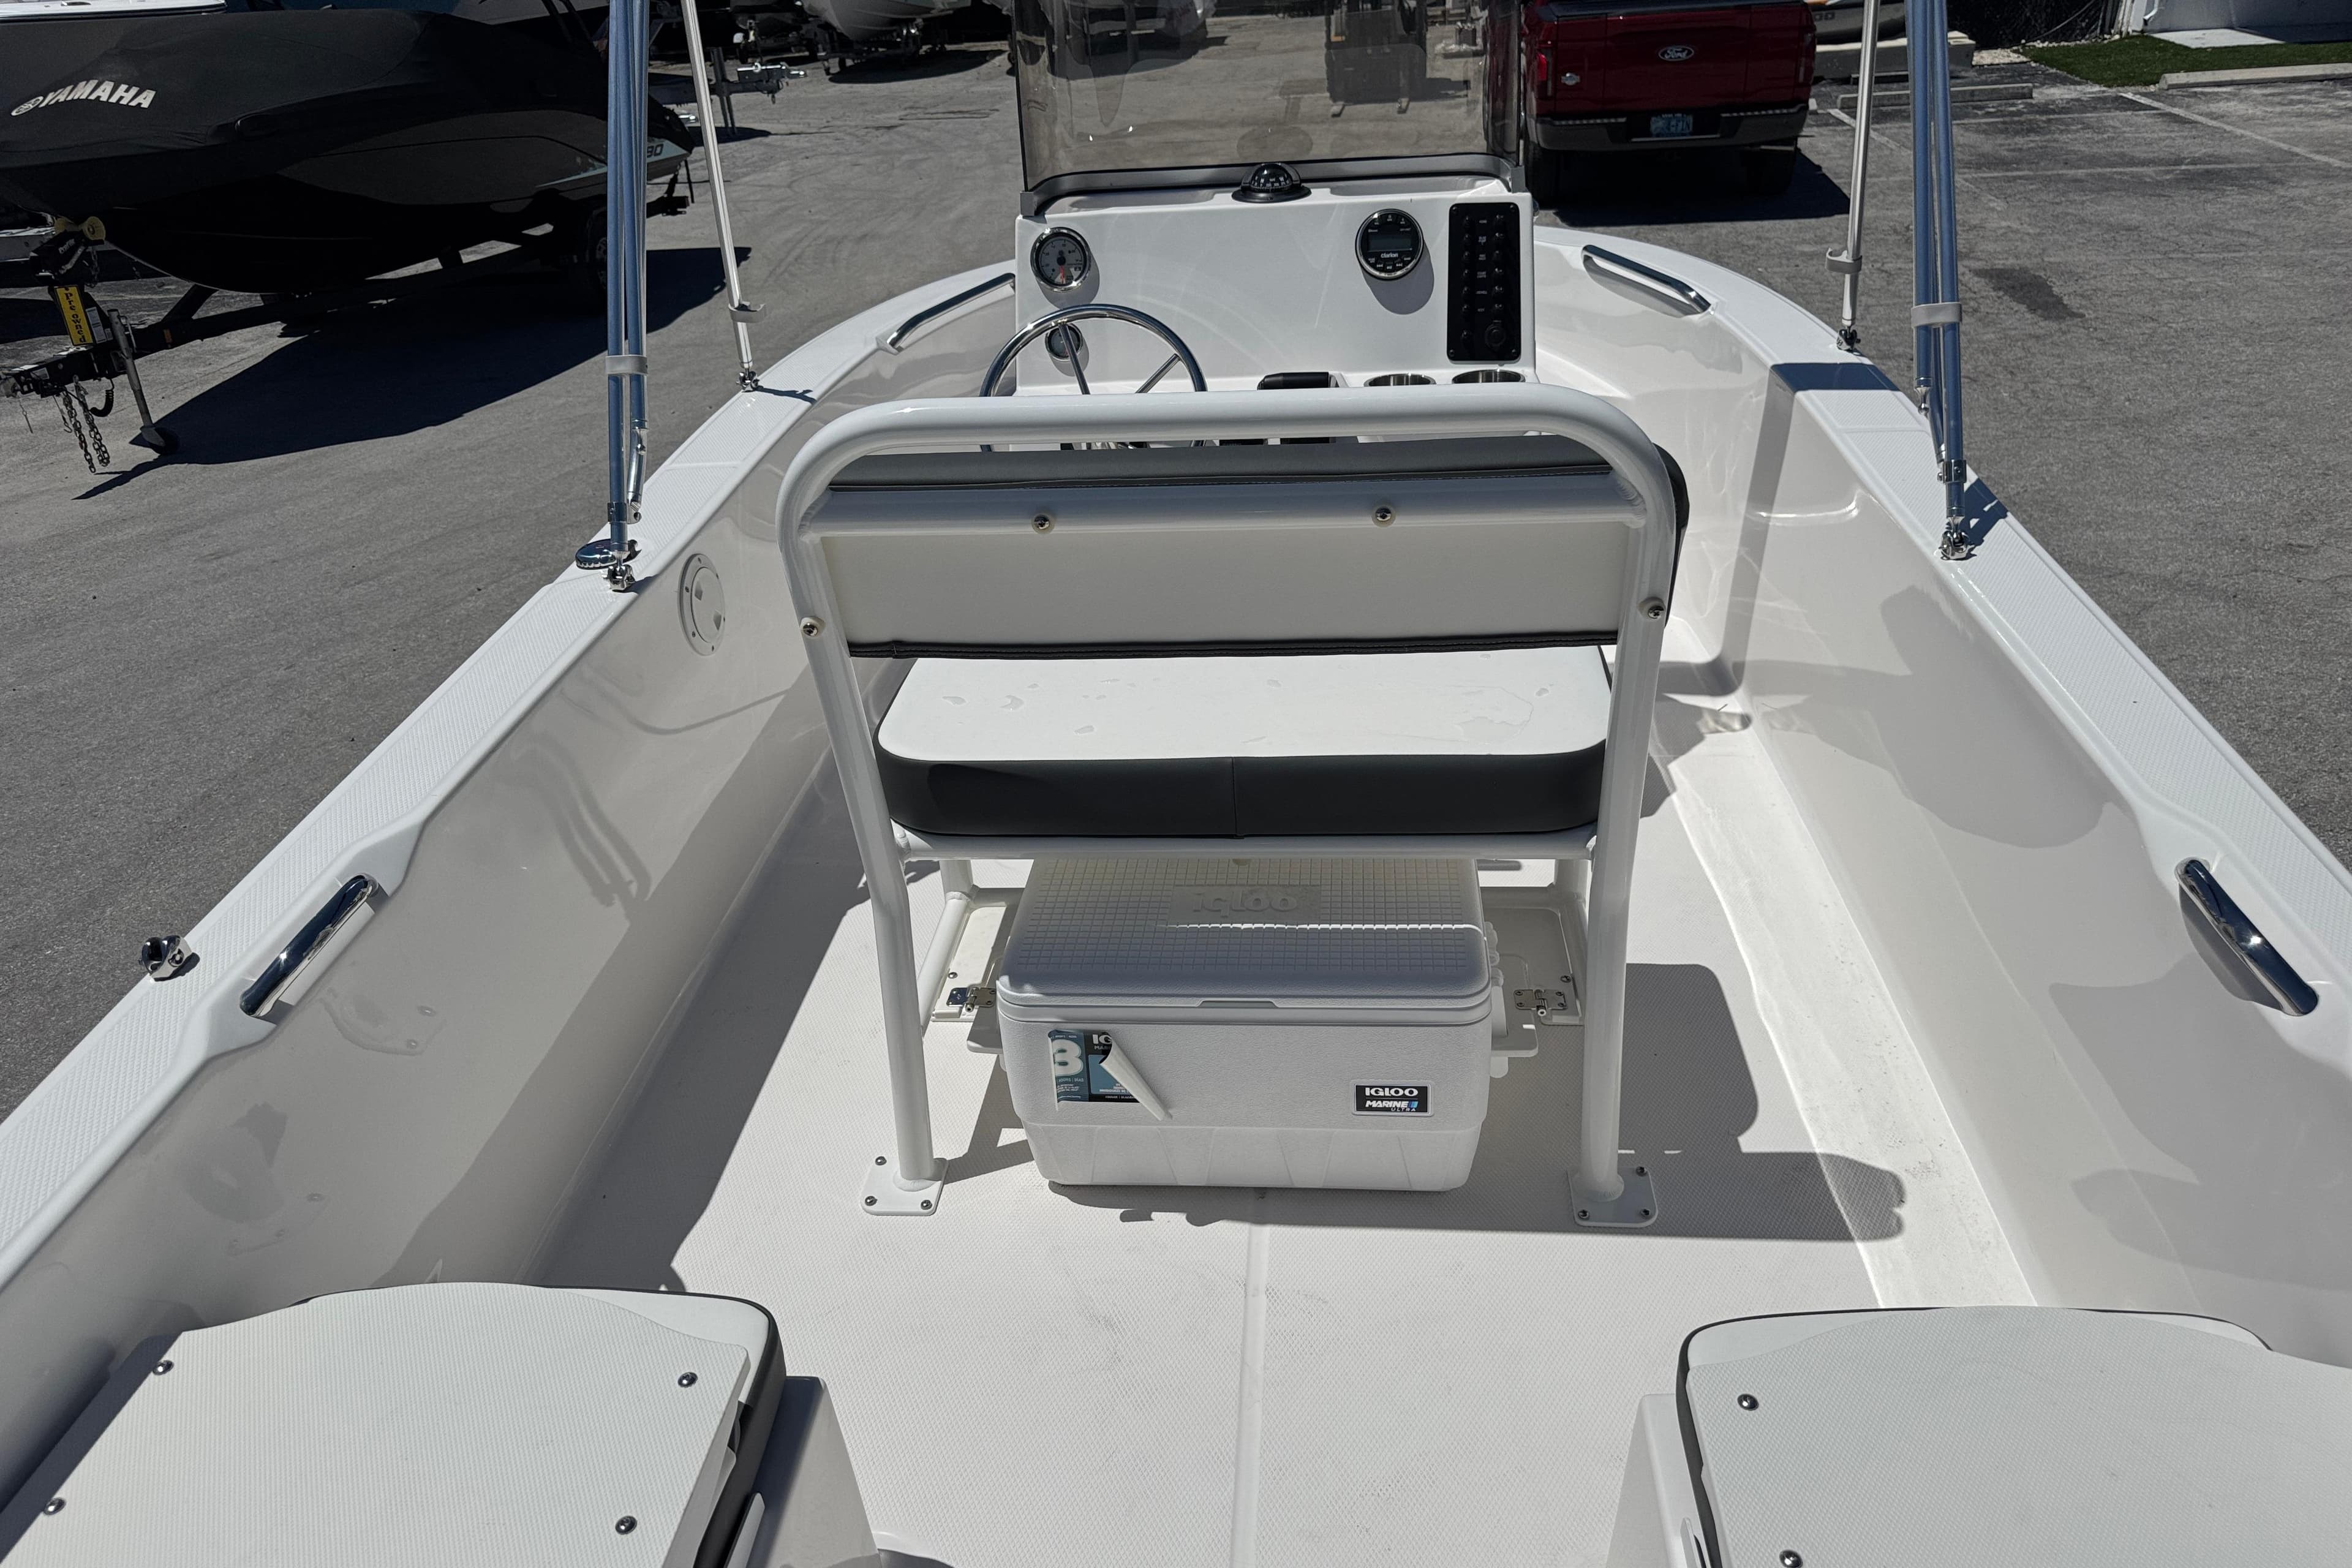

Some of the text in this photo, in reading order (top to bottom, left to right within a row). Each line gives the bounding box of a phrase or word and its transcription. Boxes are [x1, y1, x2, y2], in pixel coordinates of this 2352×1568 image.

[1663, 48, 1689, 59] Ford
[39, 80, 156, 108] YAMAHA
[72, 314, 86, 343] owned
[1365, 1087, 1419, 1096] IGLOO
